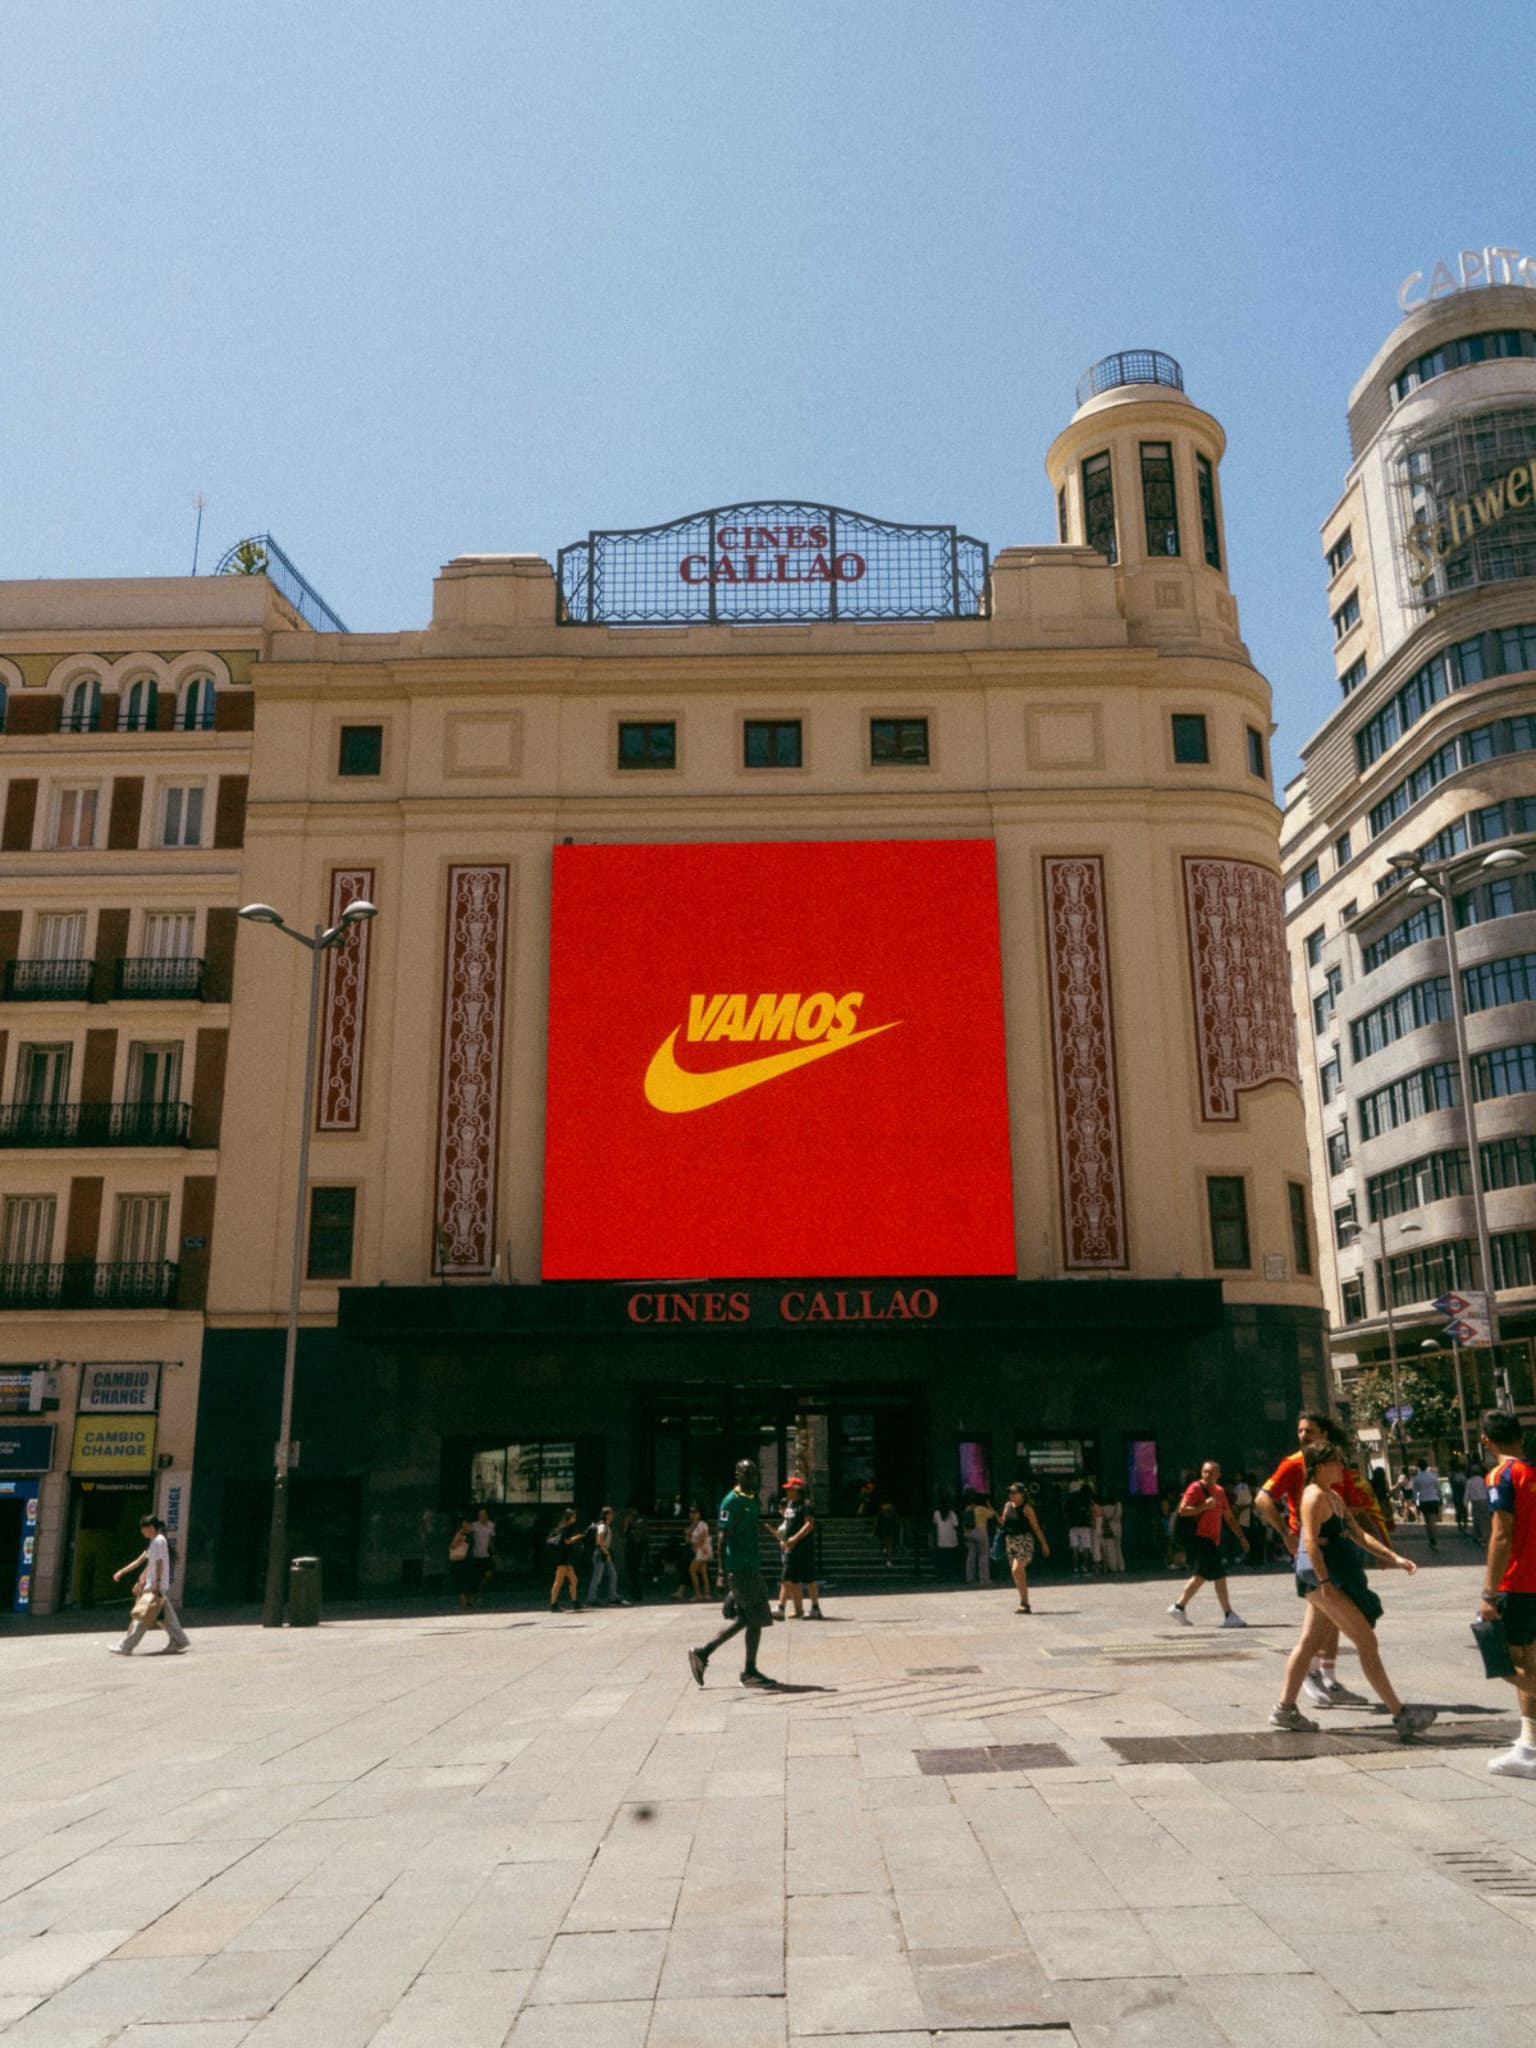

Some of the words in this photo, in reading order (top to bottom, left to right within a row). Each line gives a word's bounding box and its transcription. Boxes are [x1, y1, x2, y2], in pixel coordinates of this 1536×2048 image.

[716, 525, 829, 550] CINES
[679, 552, 866, 585] CALLAO
[686, 991, 864, 1042] VAMOS
[627, 1292, 751, 1323] CINES
[780, 1288, 939, 1322] CALLAO
[93, 1371, 150, 1388] CAMBIO
[90, 1389, 147, 1405] CHANGE
[84, 1431, 146, 1443] CAMBIO
[81, 1445, 147, 1457] CHANGE
[166, 1487, 182, 1532] CHANGE
